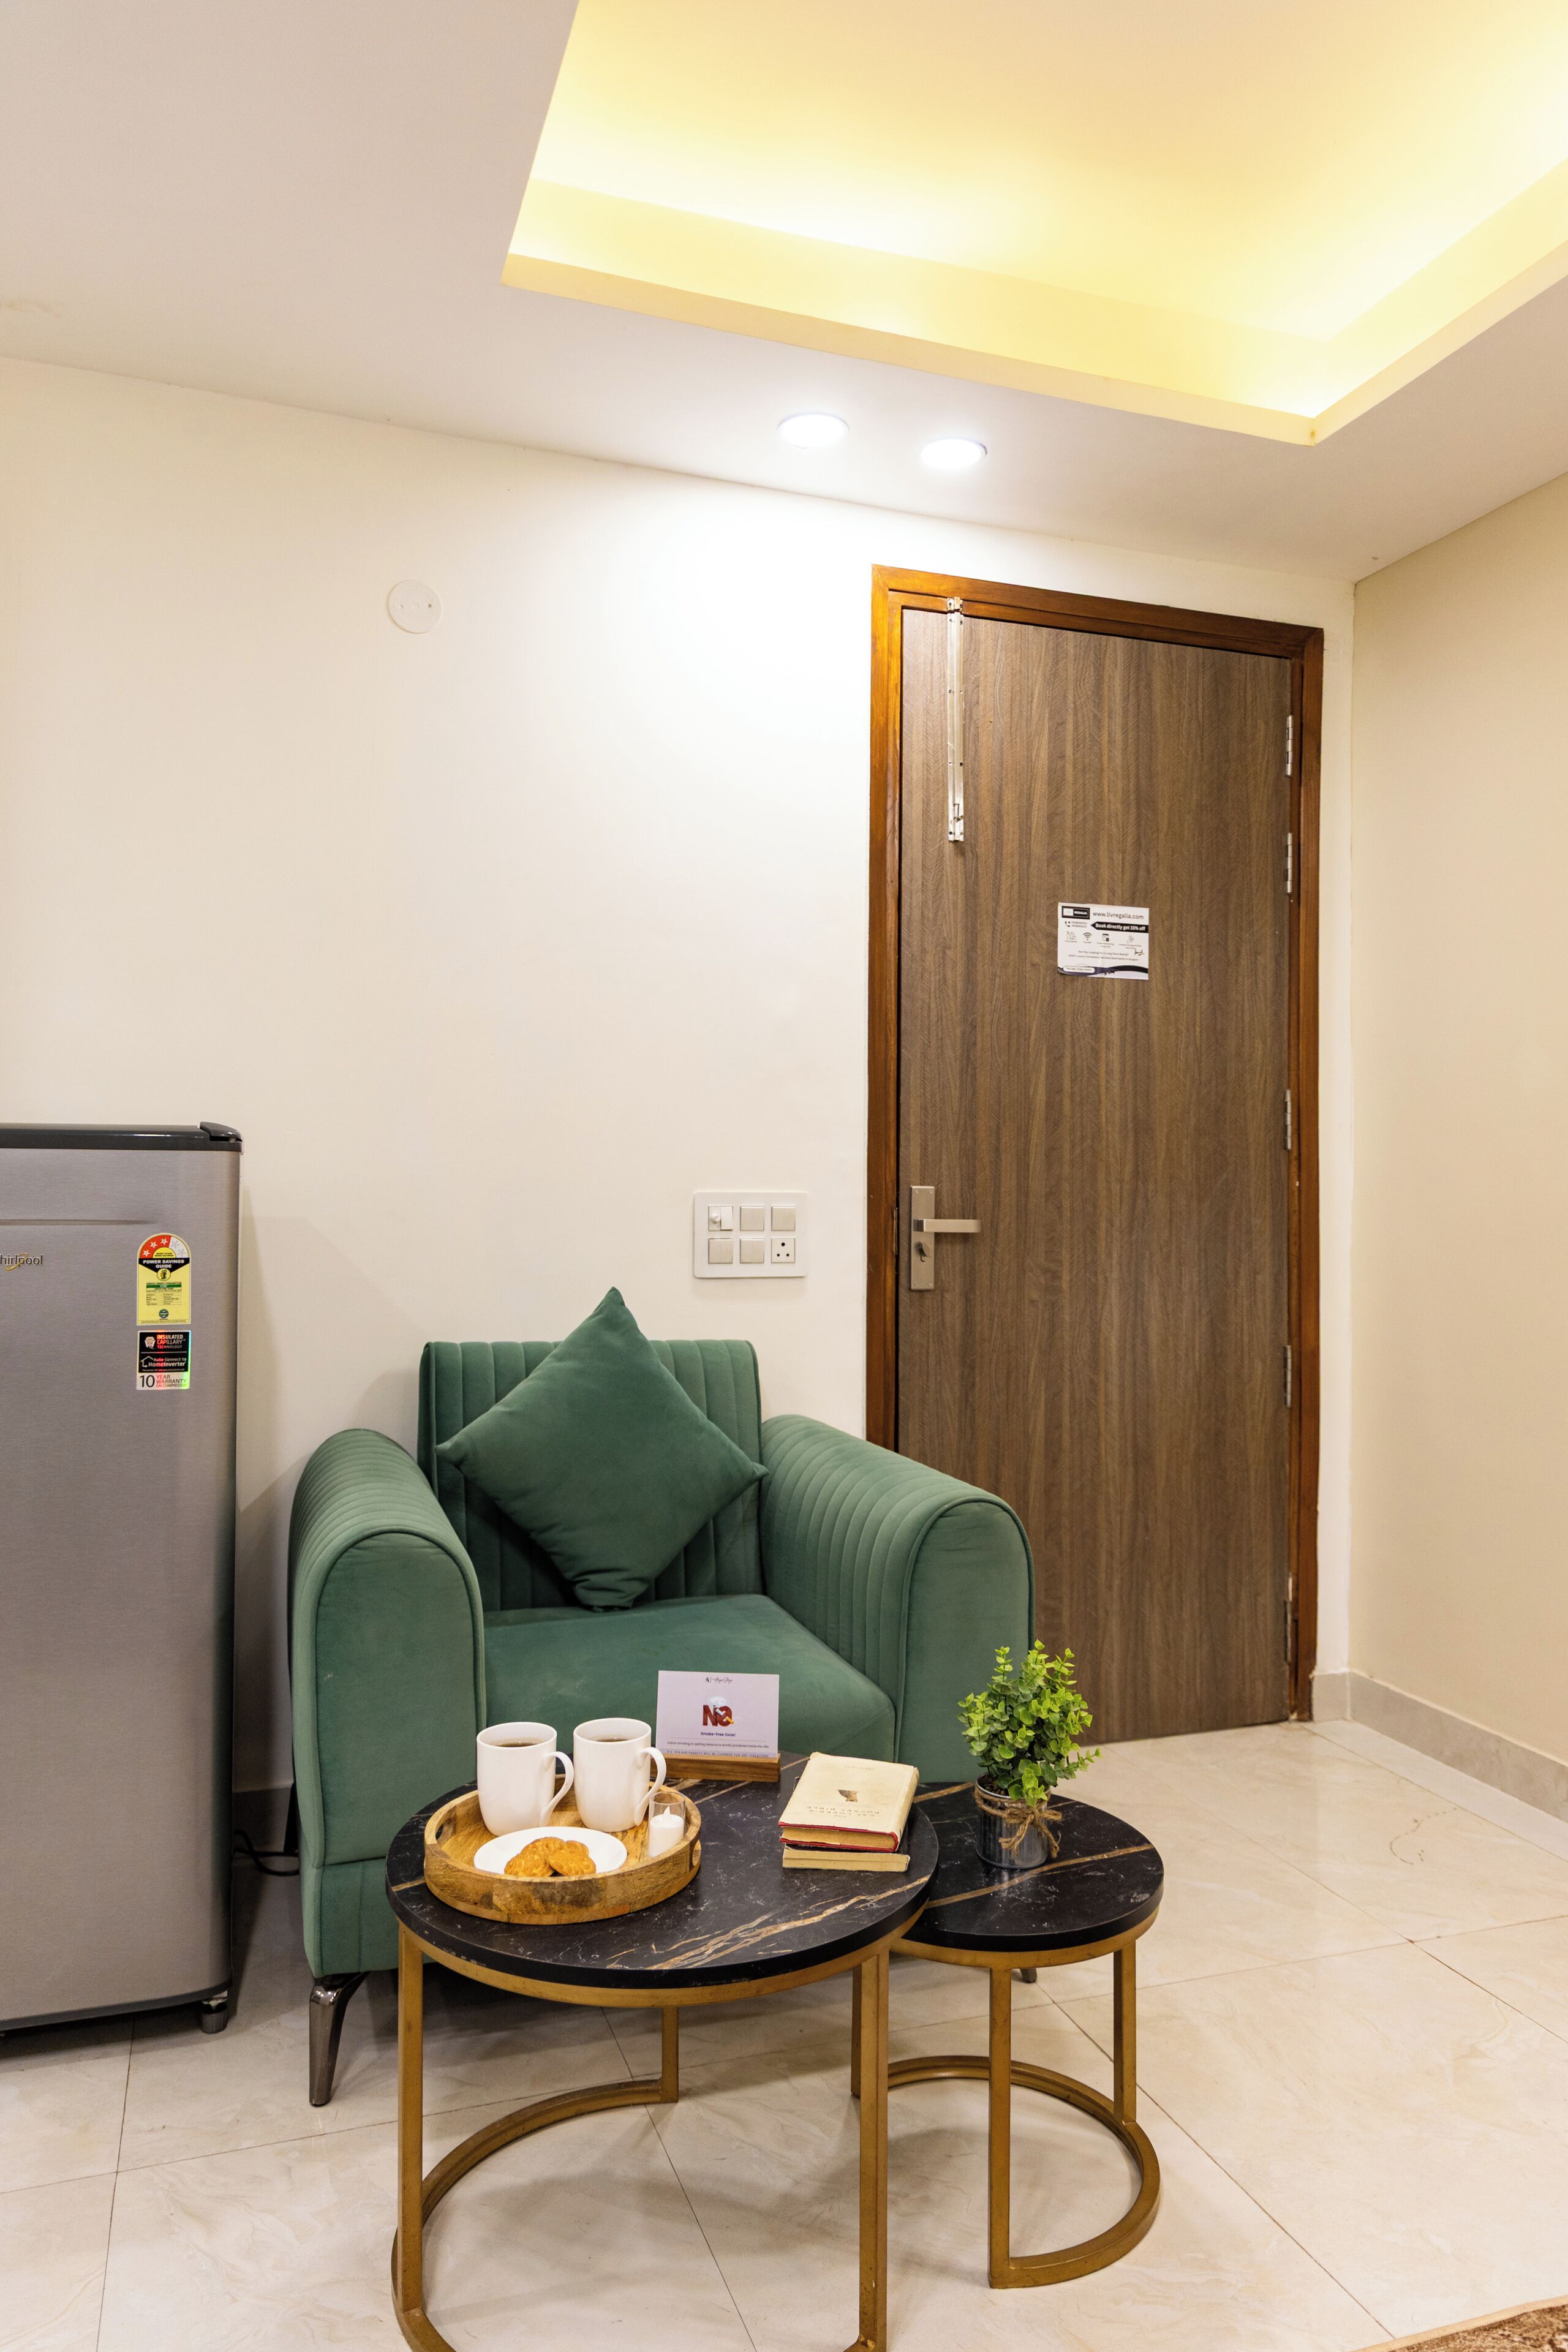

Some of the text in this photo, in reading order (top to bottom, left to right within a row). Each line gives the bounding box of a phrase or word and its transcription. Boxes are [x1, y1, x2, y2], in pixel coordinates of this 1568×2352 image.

[0, 1254, 43, 1268] hirlpool
[140, 1374, 155, 1387] 10
[703, 1705, 733, 1727] NO
